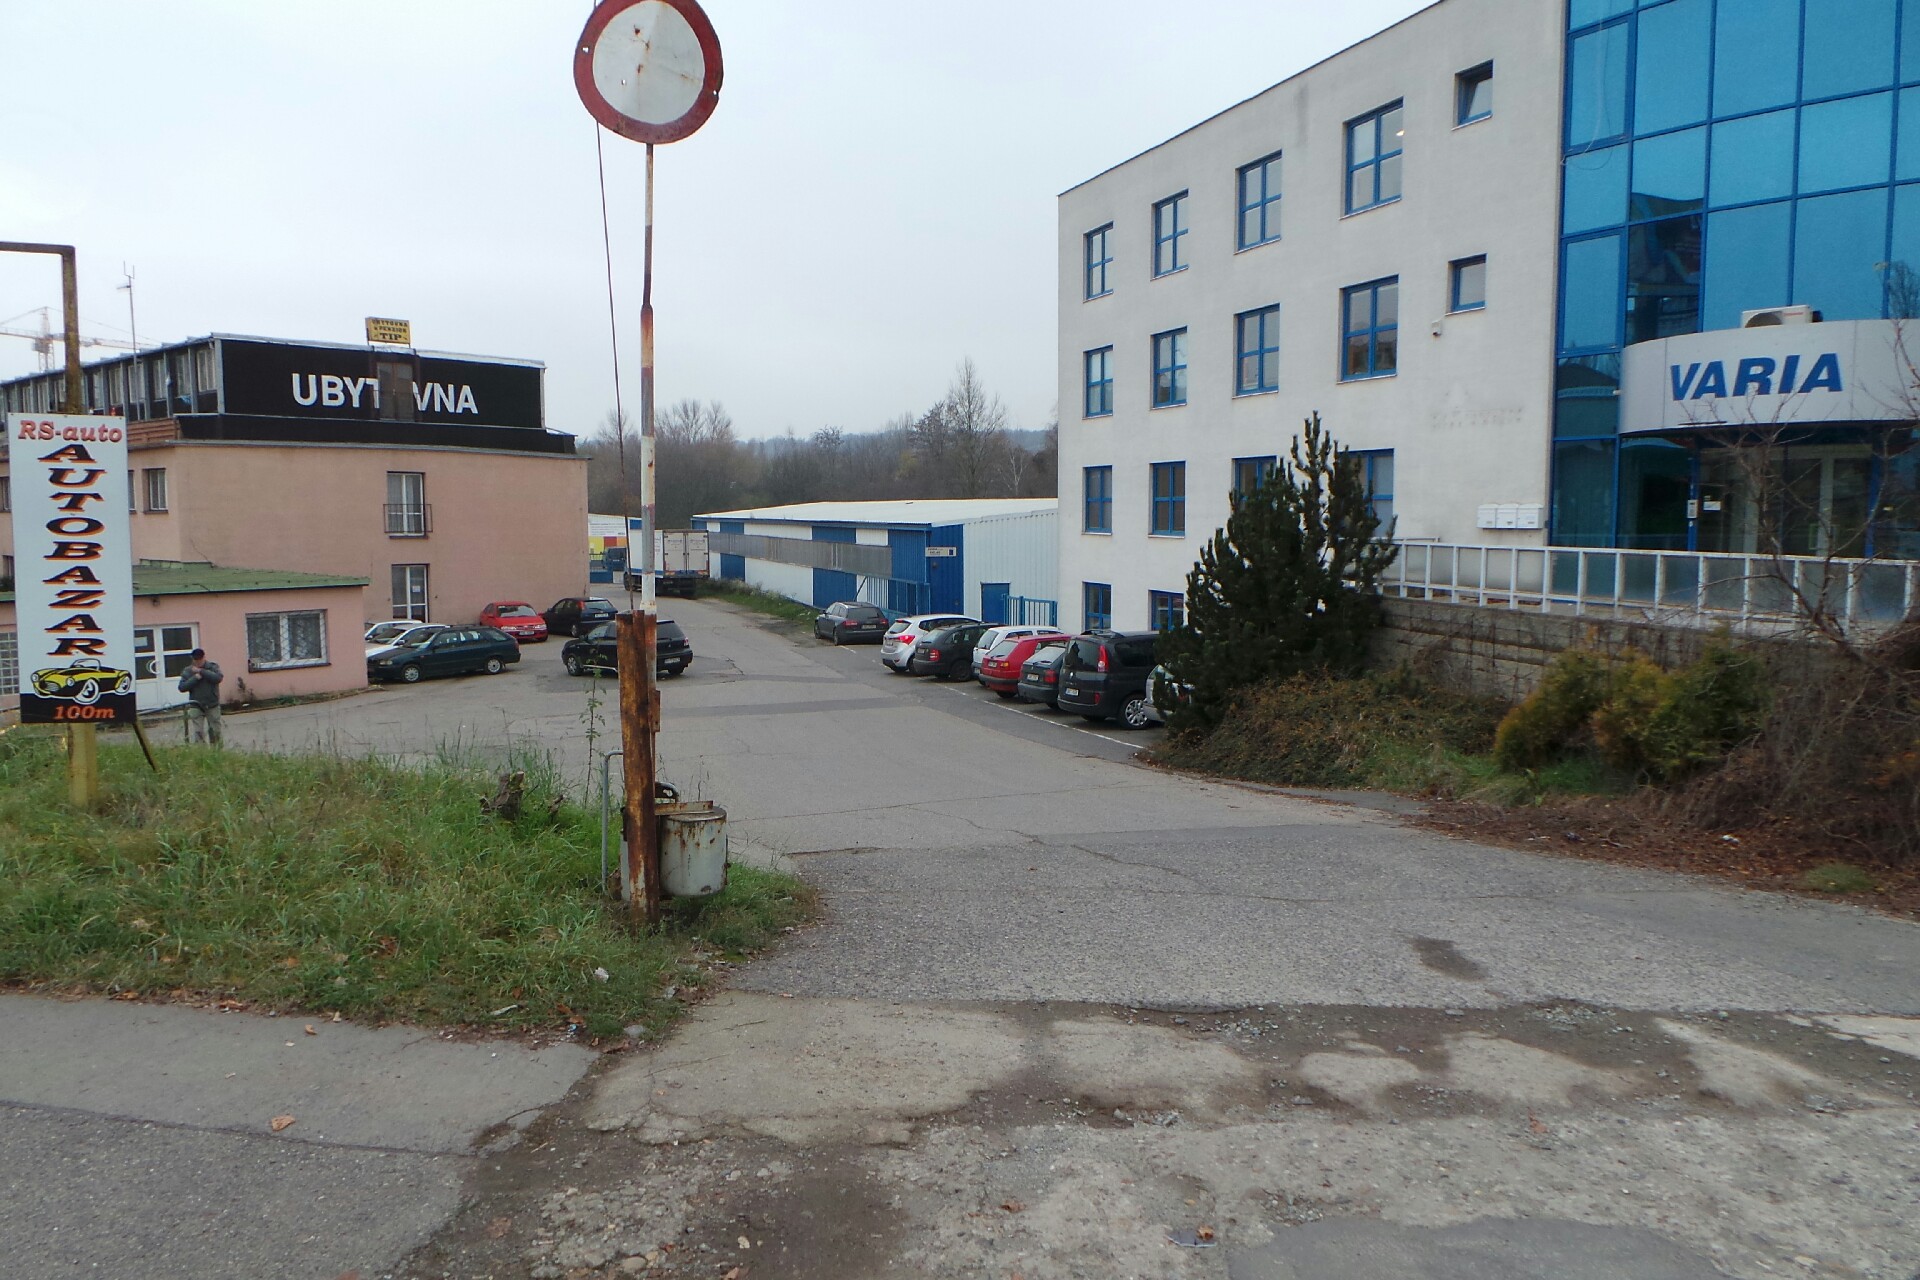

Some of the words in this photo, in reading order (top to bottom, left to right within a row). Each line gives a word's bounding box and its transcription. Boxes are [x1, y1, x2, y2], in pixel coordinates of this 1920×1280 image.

[292, 373, 478, 414] UBYTVNA
[1670, 353, 1843, 401] VARIA
[18, 420, 123, 443] RS-auto
[37, 444, 107, 656] AUTOBAZAR
[54, 705, 115, 719] 100m
